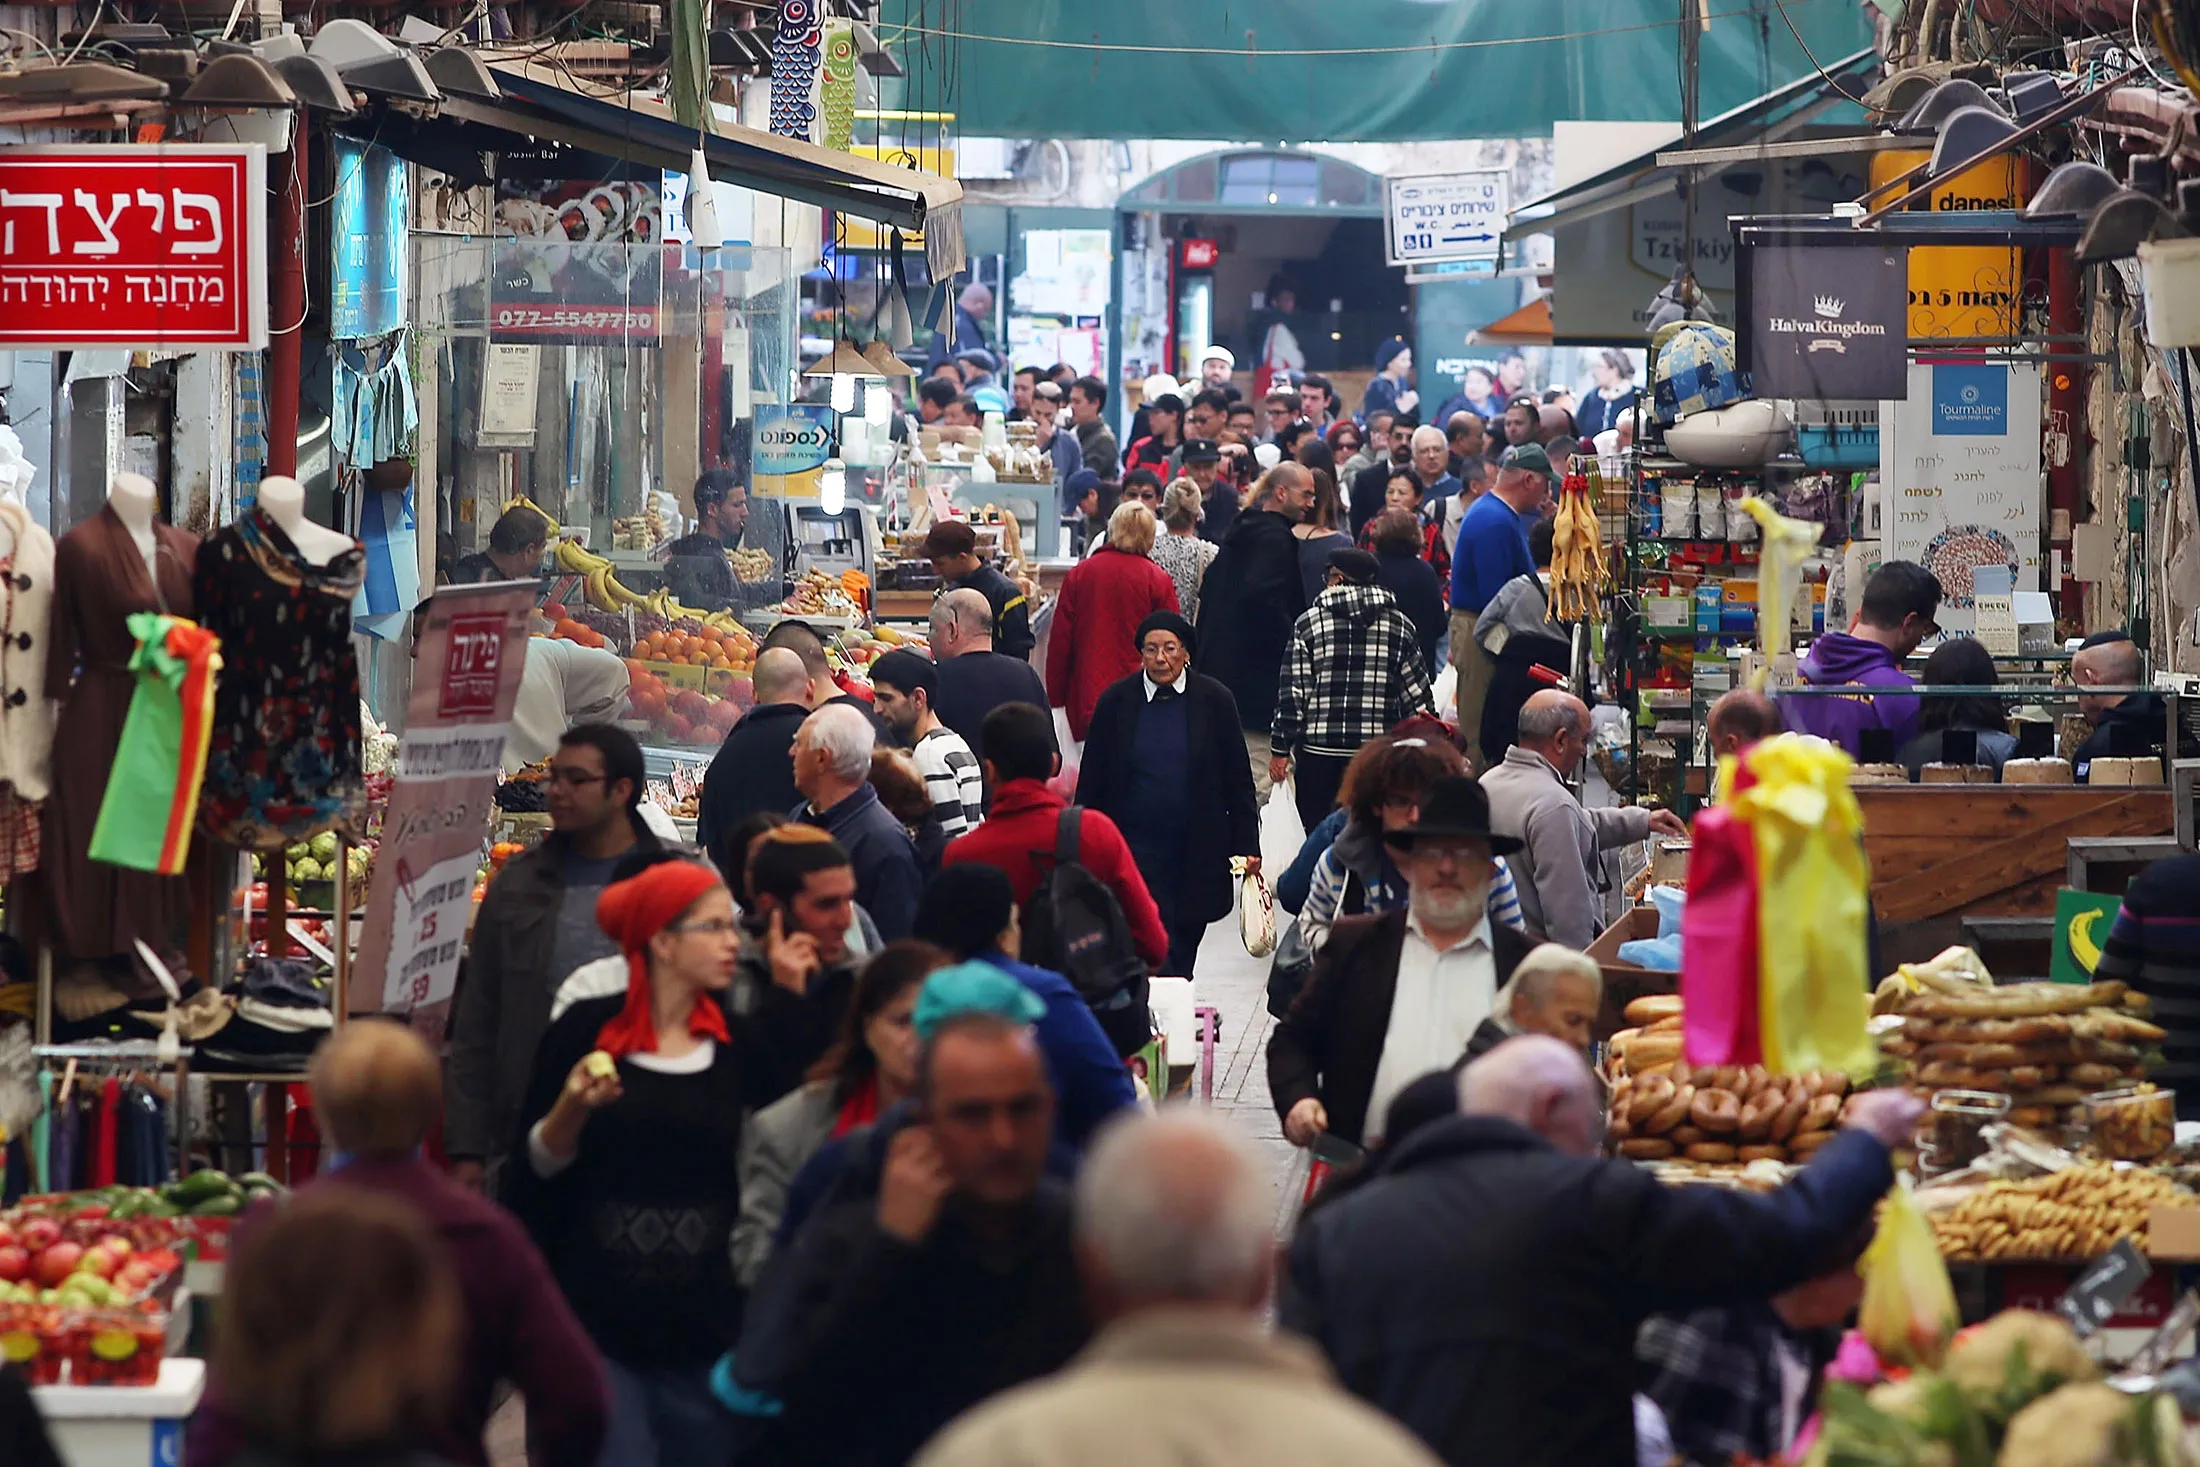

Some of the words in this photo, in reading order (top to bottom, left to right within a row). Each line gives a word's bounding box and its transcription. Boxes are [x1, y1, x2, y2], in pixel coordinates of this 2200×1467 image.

[541, 149, 559, 159] Bar
[1400, 203, 1445, 218] ציבוריים
[1450, 201, 1496, 215] שירותים
[506, 276, 529, 289] כשר
[1769, 318, 1885, 338] HalvaKingdom
[1939, 403, 2001, 415] Tourmaline
[1964, 445, 2001, 459] להעריך
[1904, 486, 1943, 498] לשמח
